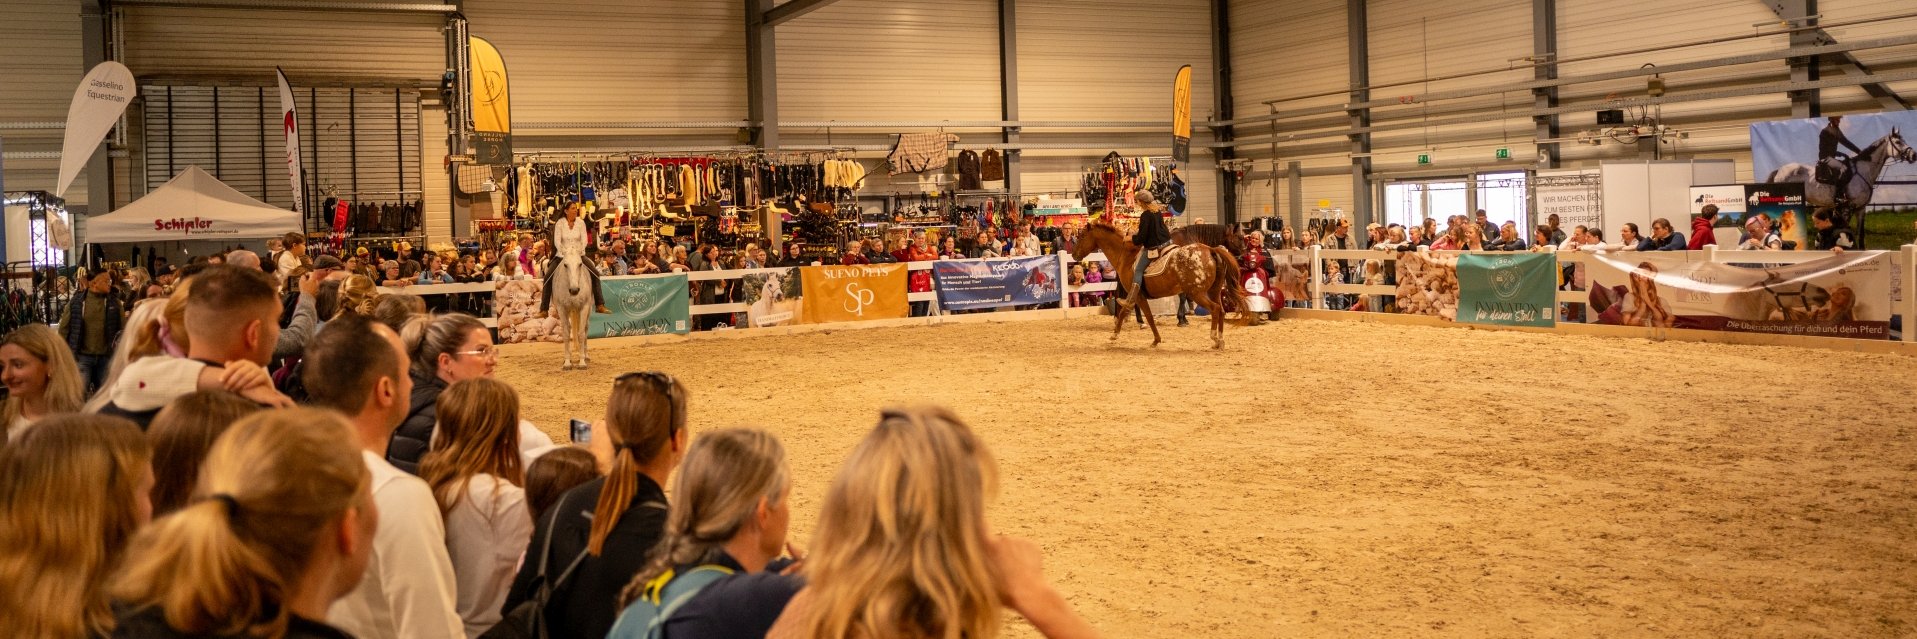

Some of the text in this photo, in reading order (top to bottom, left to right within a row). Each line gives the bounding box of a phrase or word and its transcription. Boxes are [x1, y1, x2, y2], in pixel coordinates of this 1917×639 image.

[88, 90, 124, 102] Equestrian
[1540, 149, 1547, 162] 5
[862, 267, 889, 278] PETS
[1475, 301, 1538, 313] INNOVATION
[1488, 310, 1512, 320] deinen
[603, 317, 671, 330] INNOVATION
[1726, 320, 1739, 329] Die
[1794, 324, 1805, 333] für
[1806, 324, 1821, 333] dich
[1840, 325, 1858, 333] dein
[1860, 326, 1882, 334] Pferd
[621, 327, 645, 336] deinen
